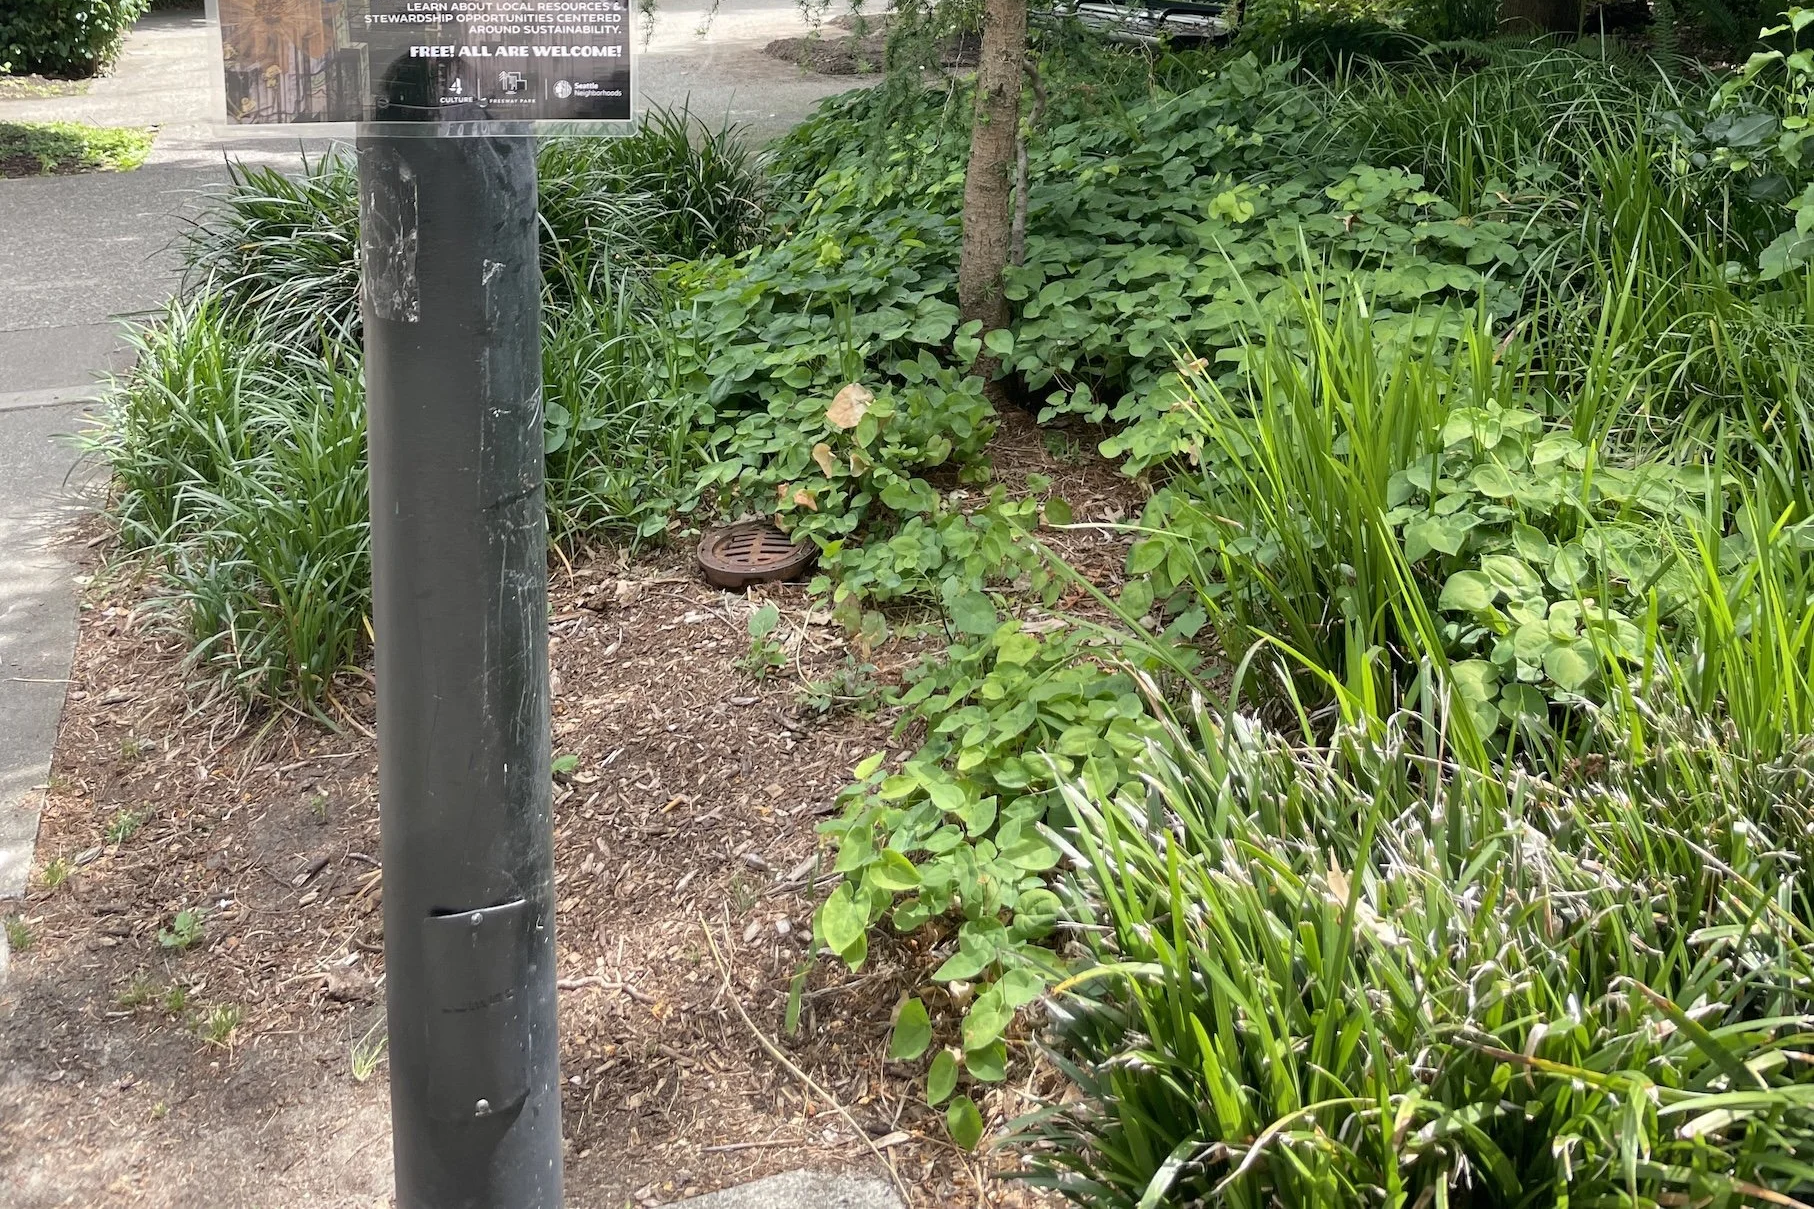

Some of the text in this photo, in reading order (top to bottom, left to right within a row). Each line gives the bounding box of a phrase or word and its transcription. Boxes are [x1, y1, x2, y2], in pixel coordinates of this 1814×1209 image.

[407, 2, 620, 11] LEARN ABOUT LOCAL RESOURCES &
[365, 14, 621, 23] STEWARDSHIP OPPORTUNITIES CENTERED
[469, 25, 621, 34] AROUND SUSTAINABILITY.
[410, 46, 622, 57] FREE! ALL ARE WELCOME!
[449, 78, 462, 94] 4
